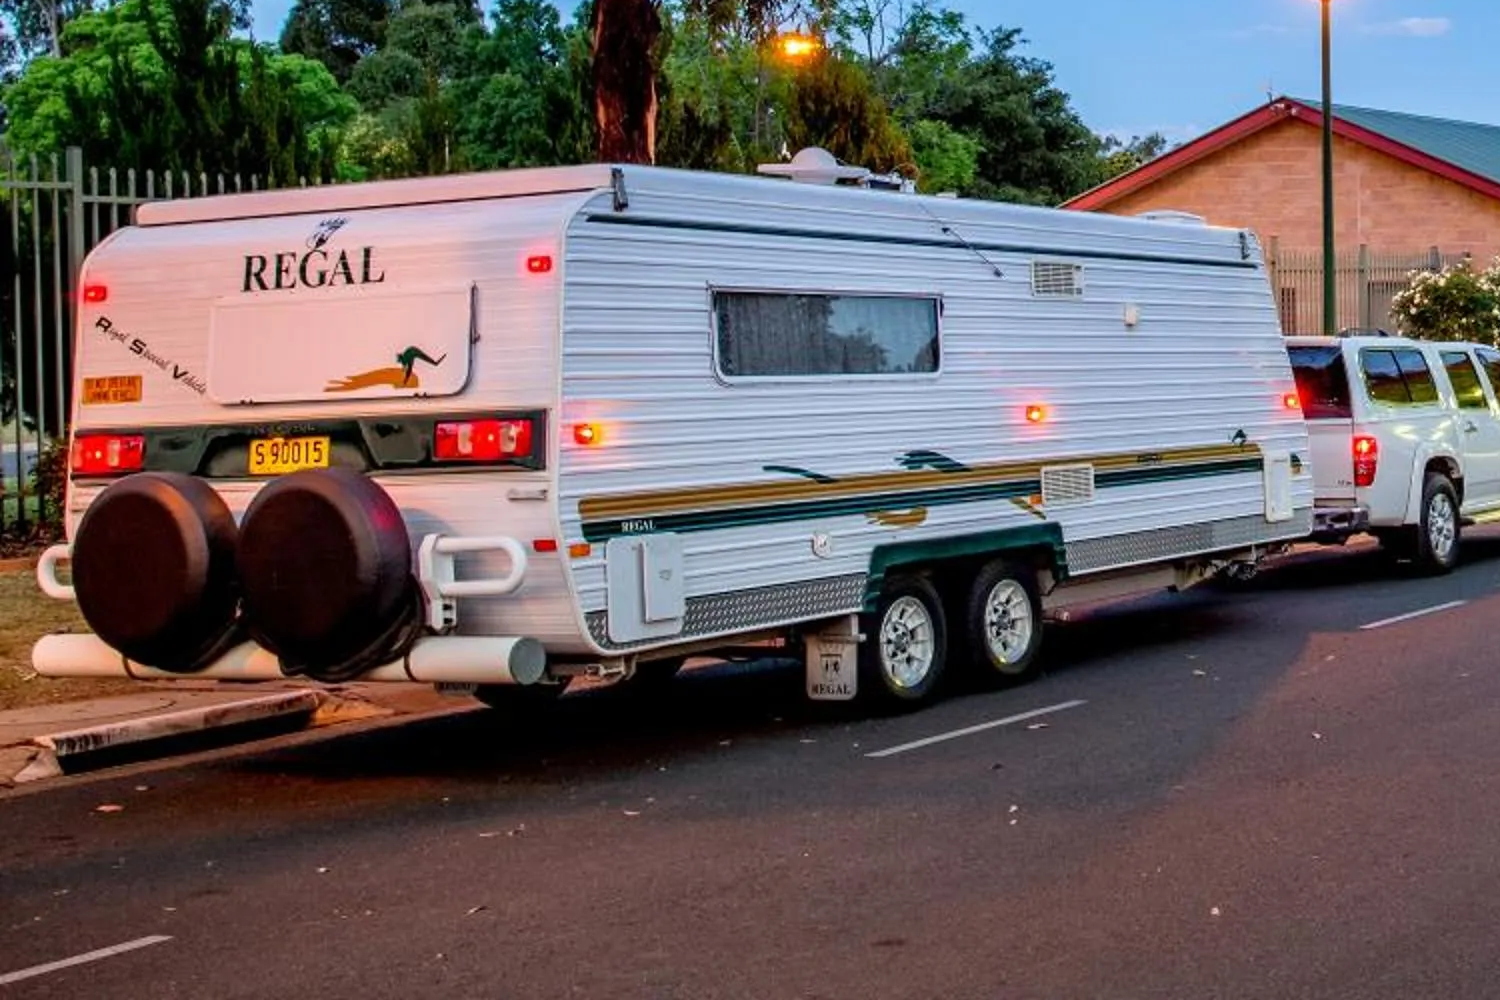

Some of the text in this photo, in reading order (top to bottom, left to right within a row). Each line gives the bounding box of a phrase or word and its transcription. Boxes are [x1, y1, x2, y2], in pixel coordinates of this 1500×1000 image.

[241, 246, 385, 292] REGAL
[621, 520, 657, 532] REGAL
[811, 683, 851, 695] REGAL
